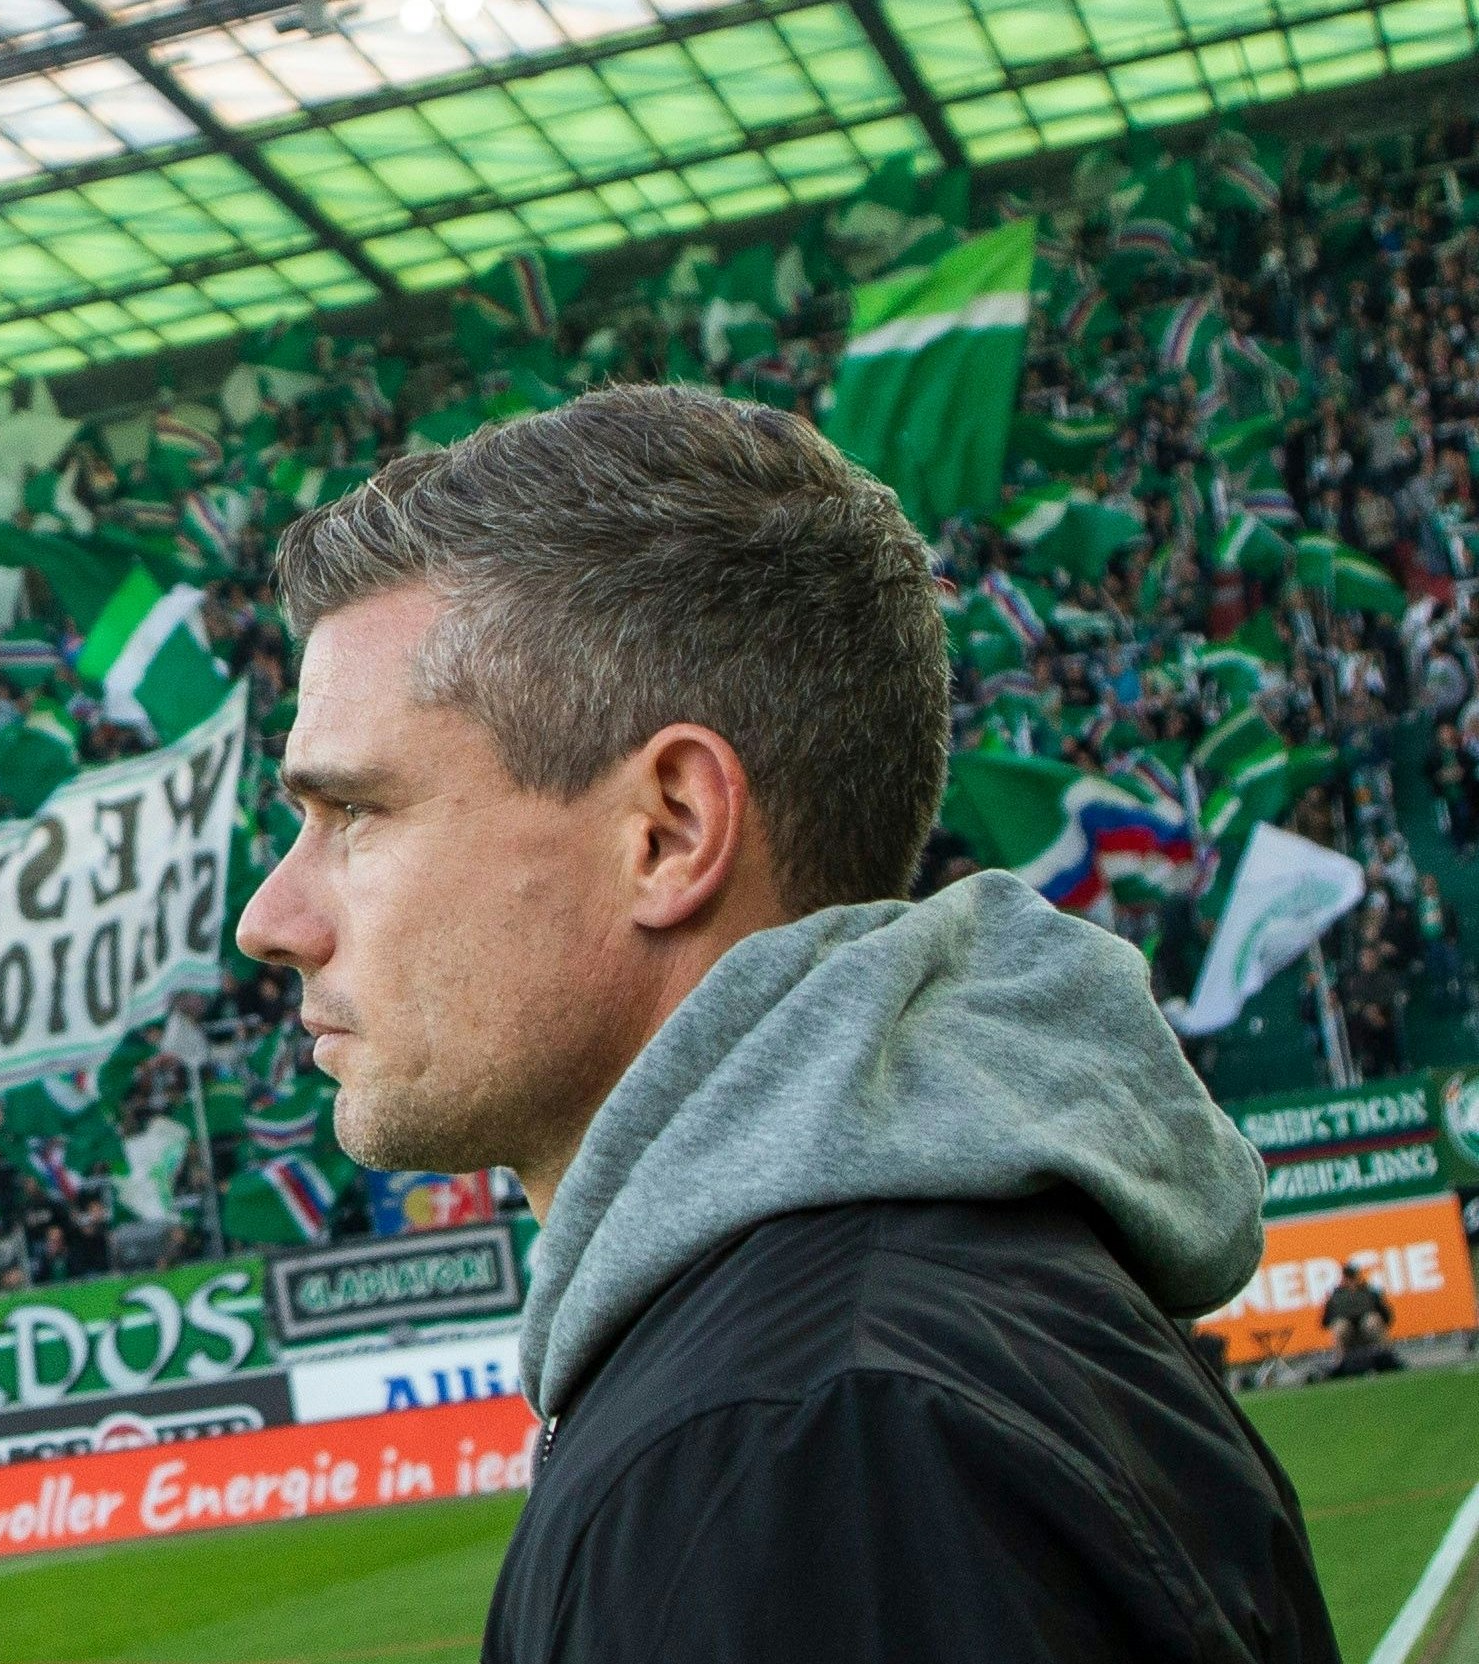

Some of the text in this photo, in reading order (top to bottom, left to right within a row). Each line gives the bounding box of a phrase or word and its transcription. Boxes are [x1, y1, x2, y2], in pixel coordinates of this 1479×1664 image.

[299, 1248, 498, 1310] GLADIATORI
[385, 1361, 520, 1412] Alli
[140, 1450, 359, 1532] Energie
[376, 1445, 434, 1500] in
